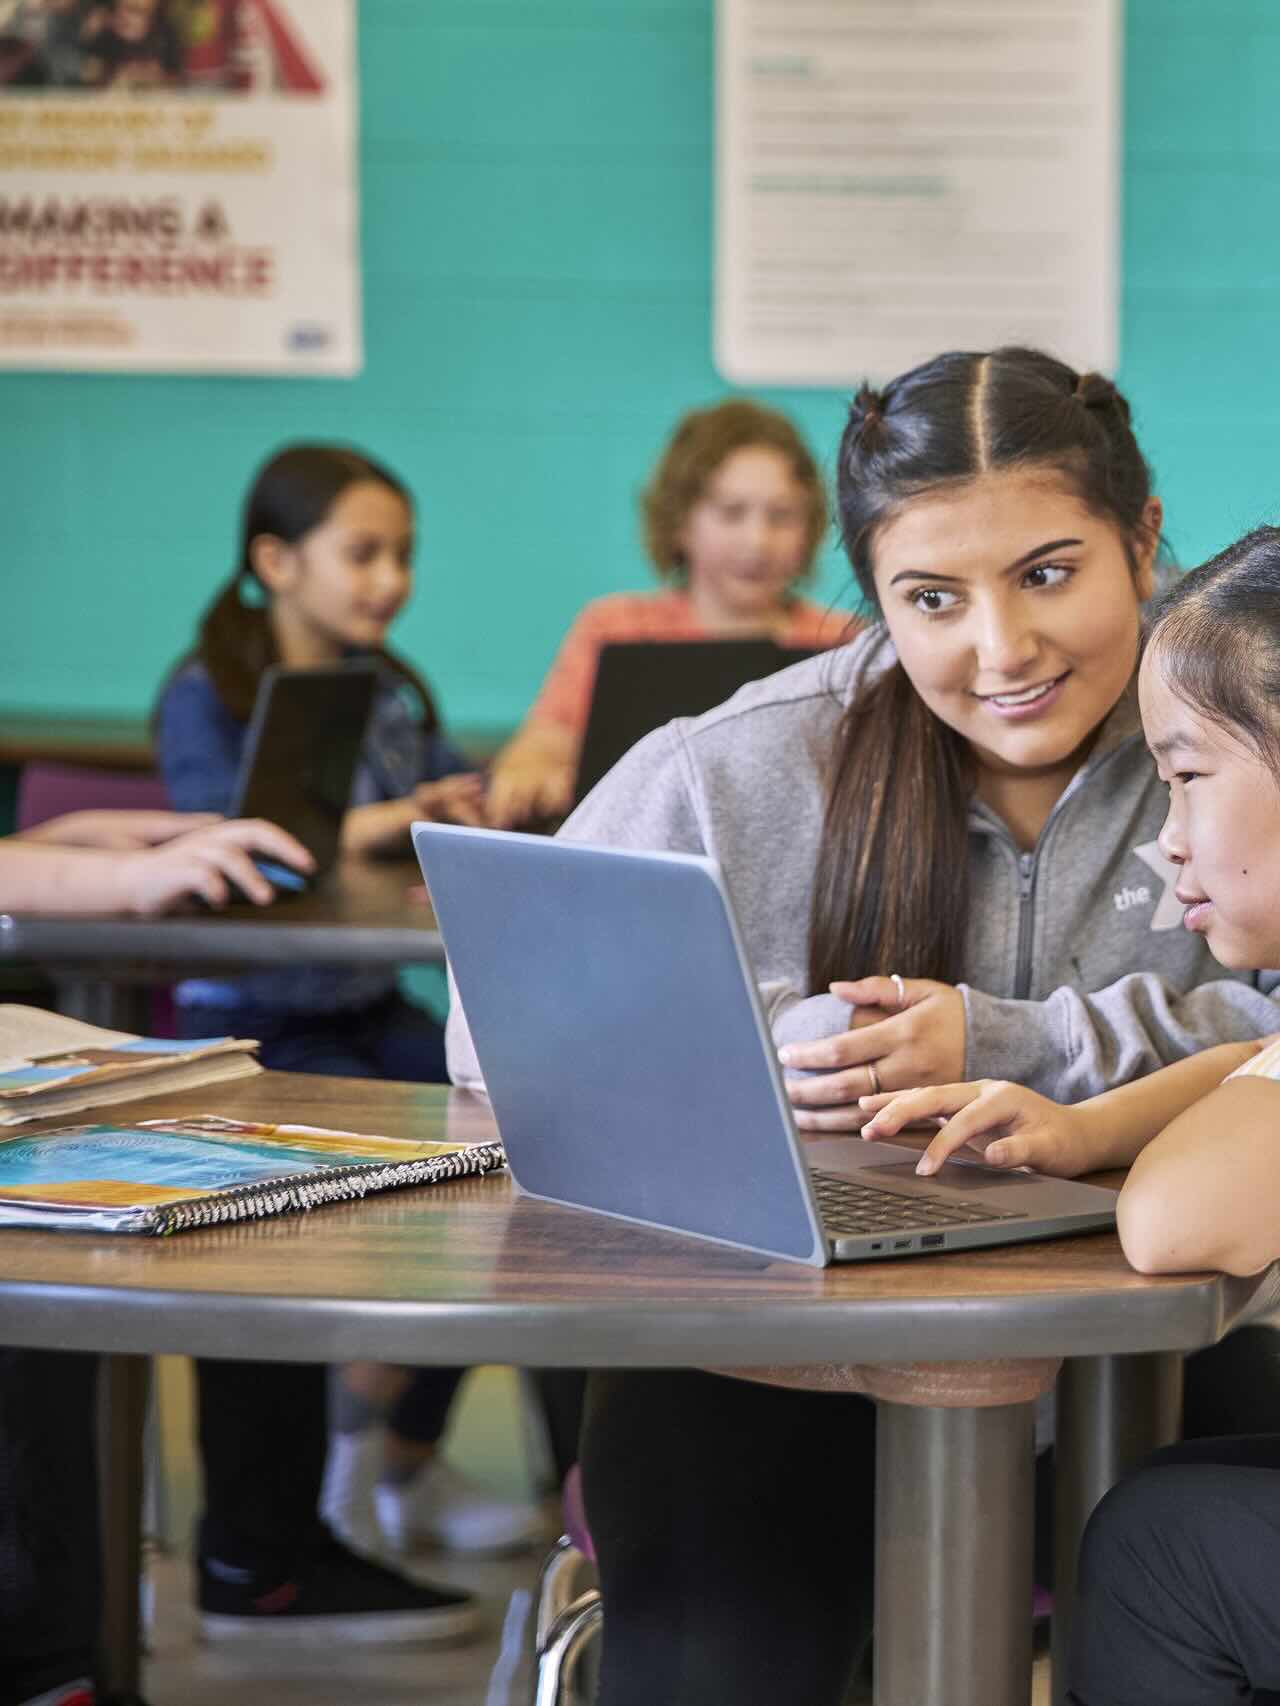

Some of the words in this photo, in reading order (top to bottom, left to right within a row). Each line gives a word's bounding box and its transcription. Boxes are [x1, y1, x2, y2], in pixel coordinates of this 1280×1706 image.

[0, 199, 178, 240] MAKING
[194, 199, 228, 239] A
[0, 251, 272, 291] DIFFERENCE
[1113, 886, 1150, 911] the
